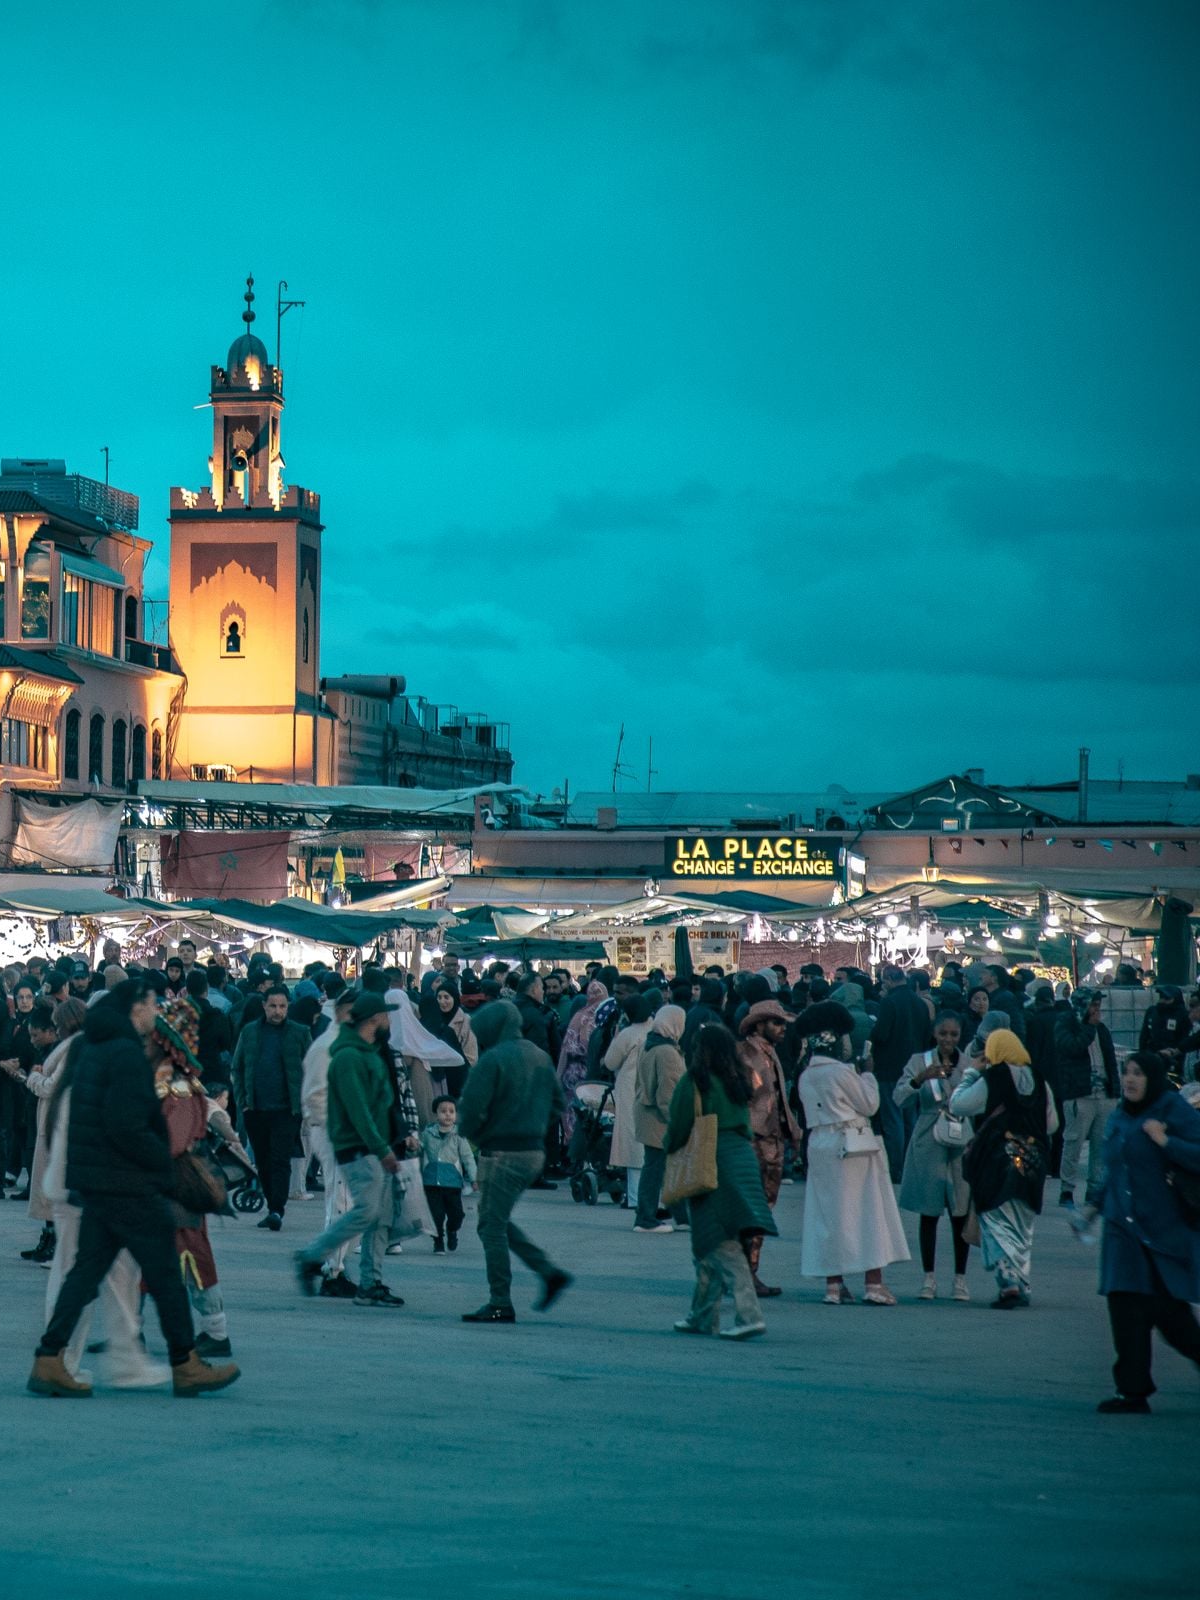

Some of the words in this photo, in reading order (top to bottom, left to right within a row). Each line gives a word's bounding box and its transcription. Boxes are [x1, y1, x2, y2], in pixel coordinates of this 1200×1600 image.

[677, 838, 710, 859] LA
[724, 838, 808, 859] PLACE
[673, 860, 735, 875] CHANGE
[753, 860, 834, 875] EXCHANGE
[688, 930, 709, 940] CHEZ
